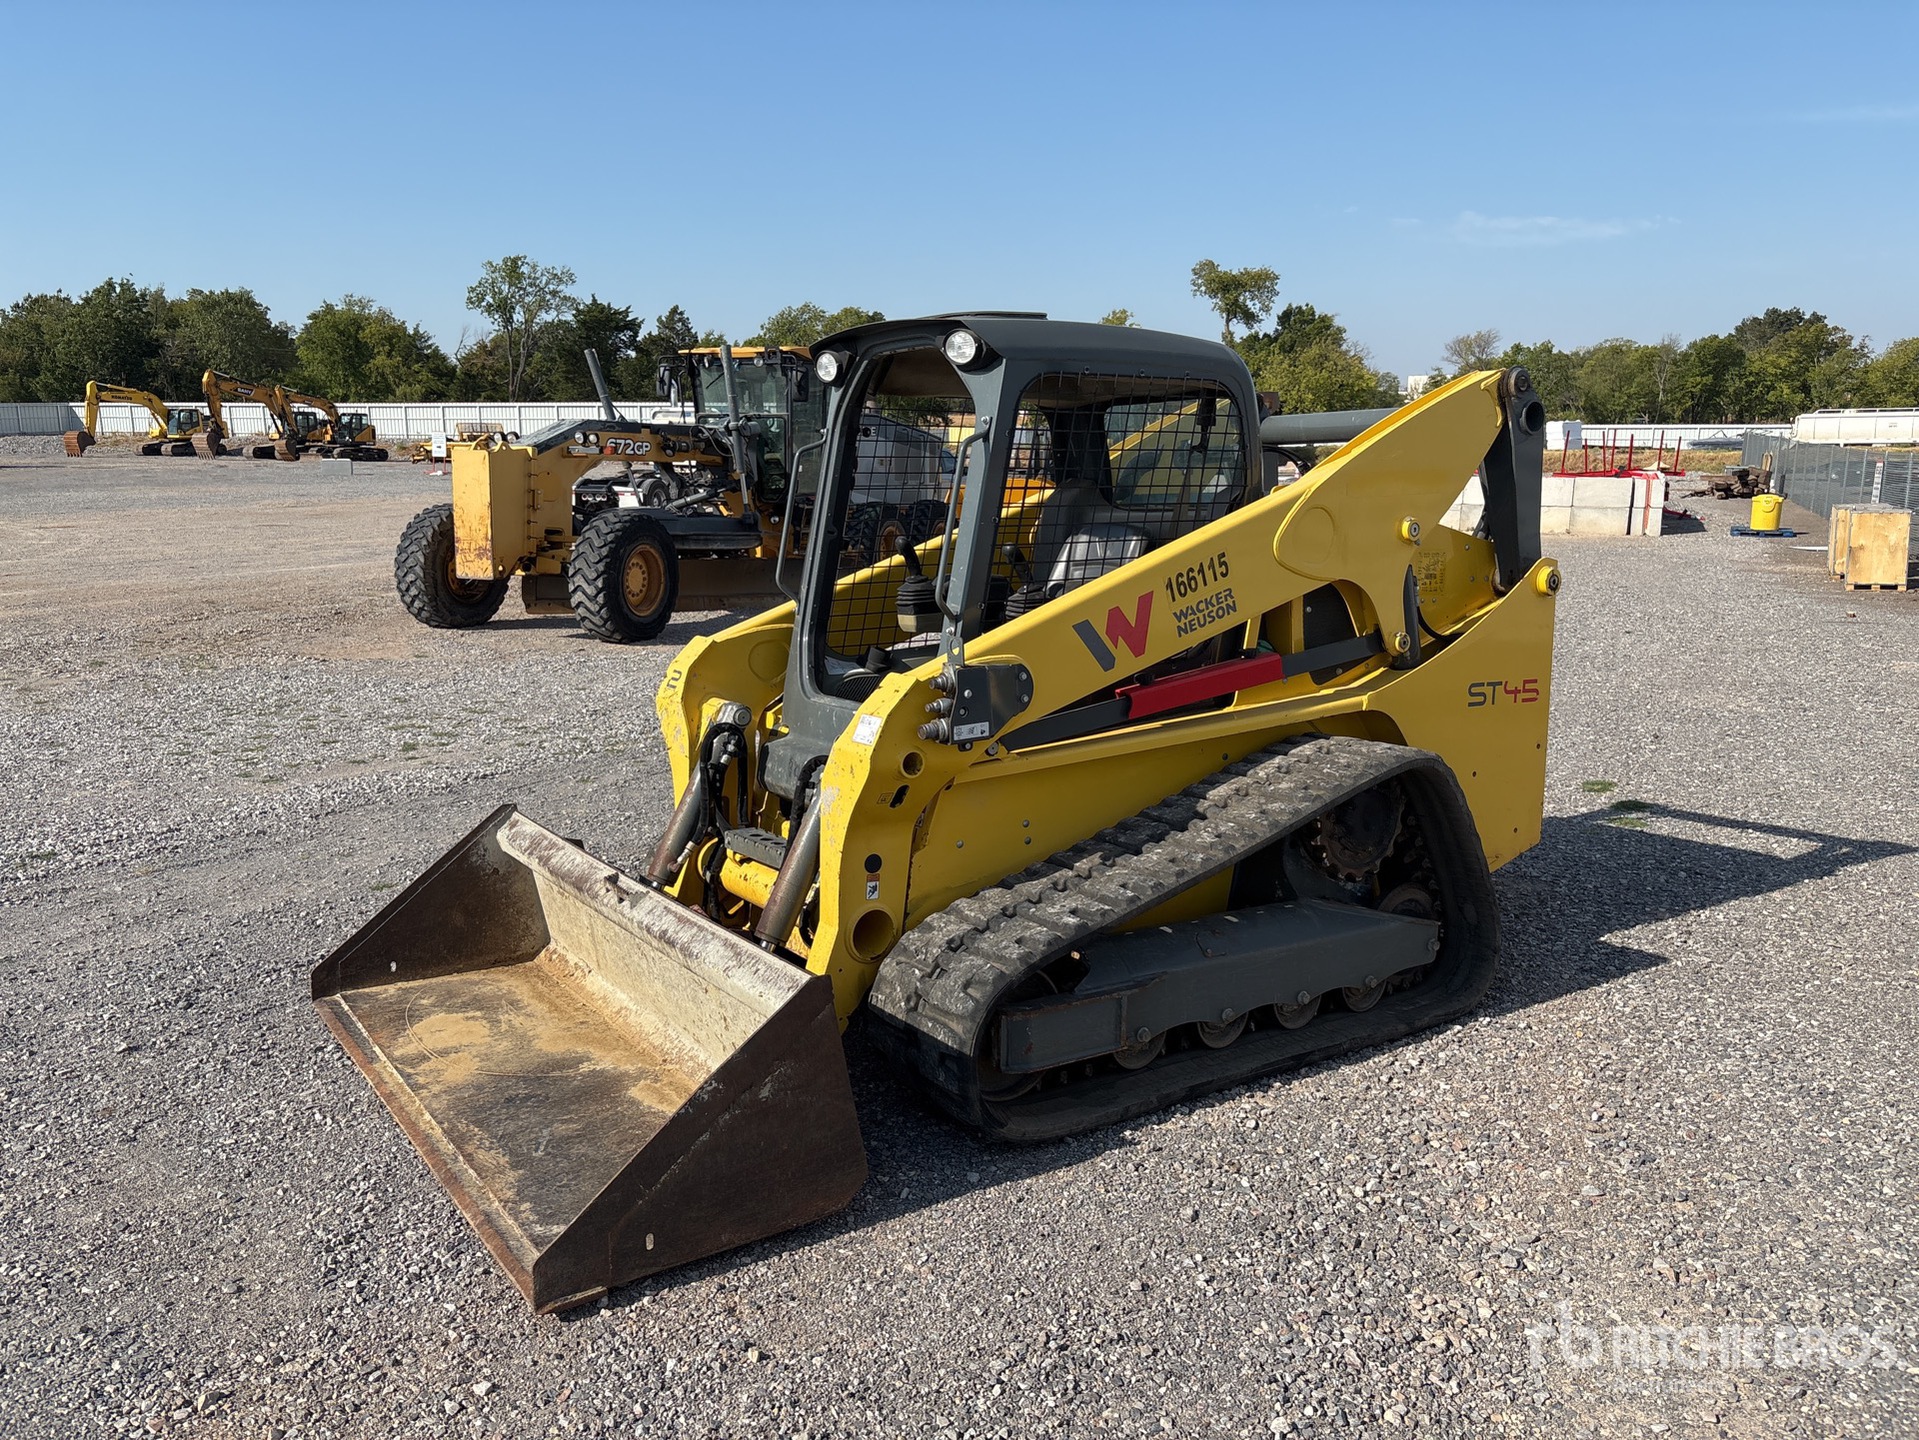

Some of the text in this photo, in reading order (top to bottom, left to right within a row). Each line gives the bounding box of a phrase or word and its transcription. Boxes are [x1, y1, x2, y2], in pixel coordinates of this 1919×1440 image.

[1165, 552, 1230, 602] 166115
[1172, 588, 1235, 623] WACKER
[1176, 600, 1237, 638] NEUSON
[1467, 678, 1540, 708] ST45
